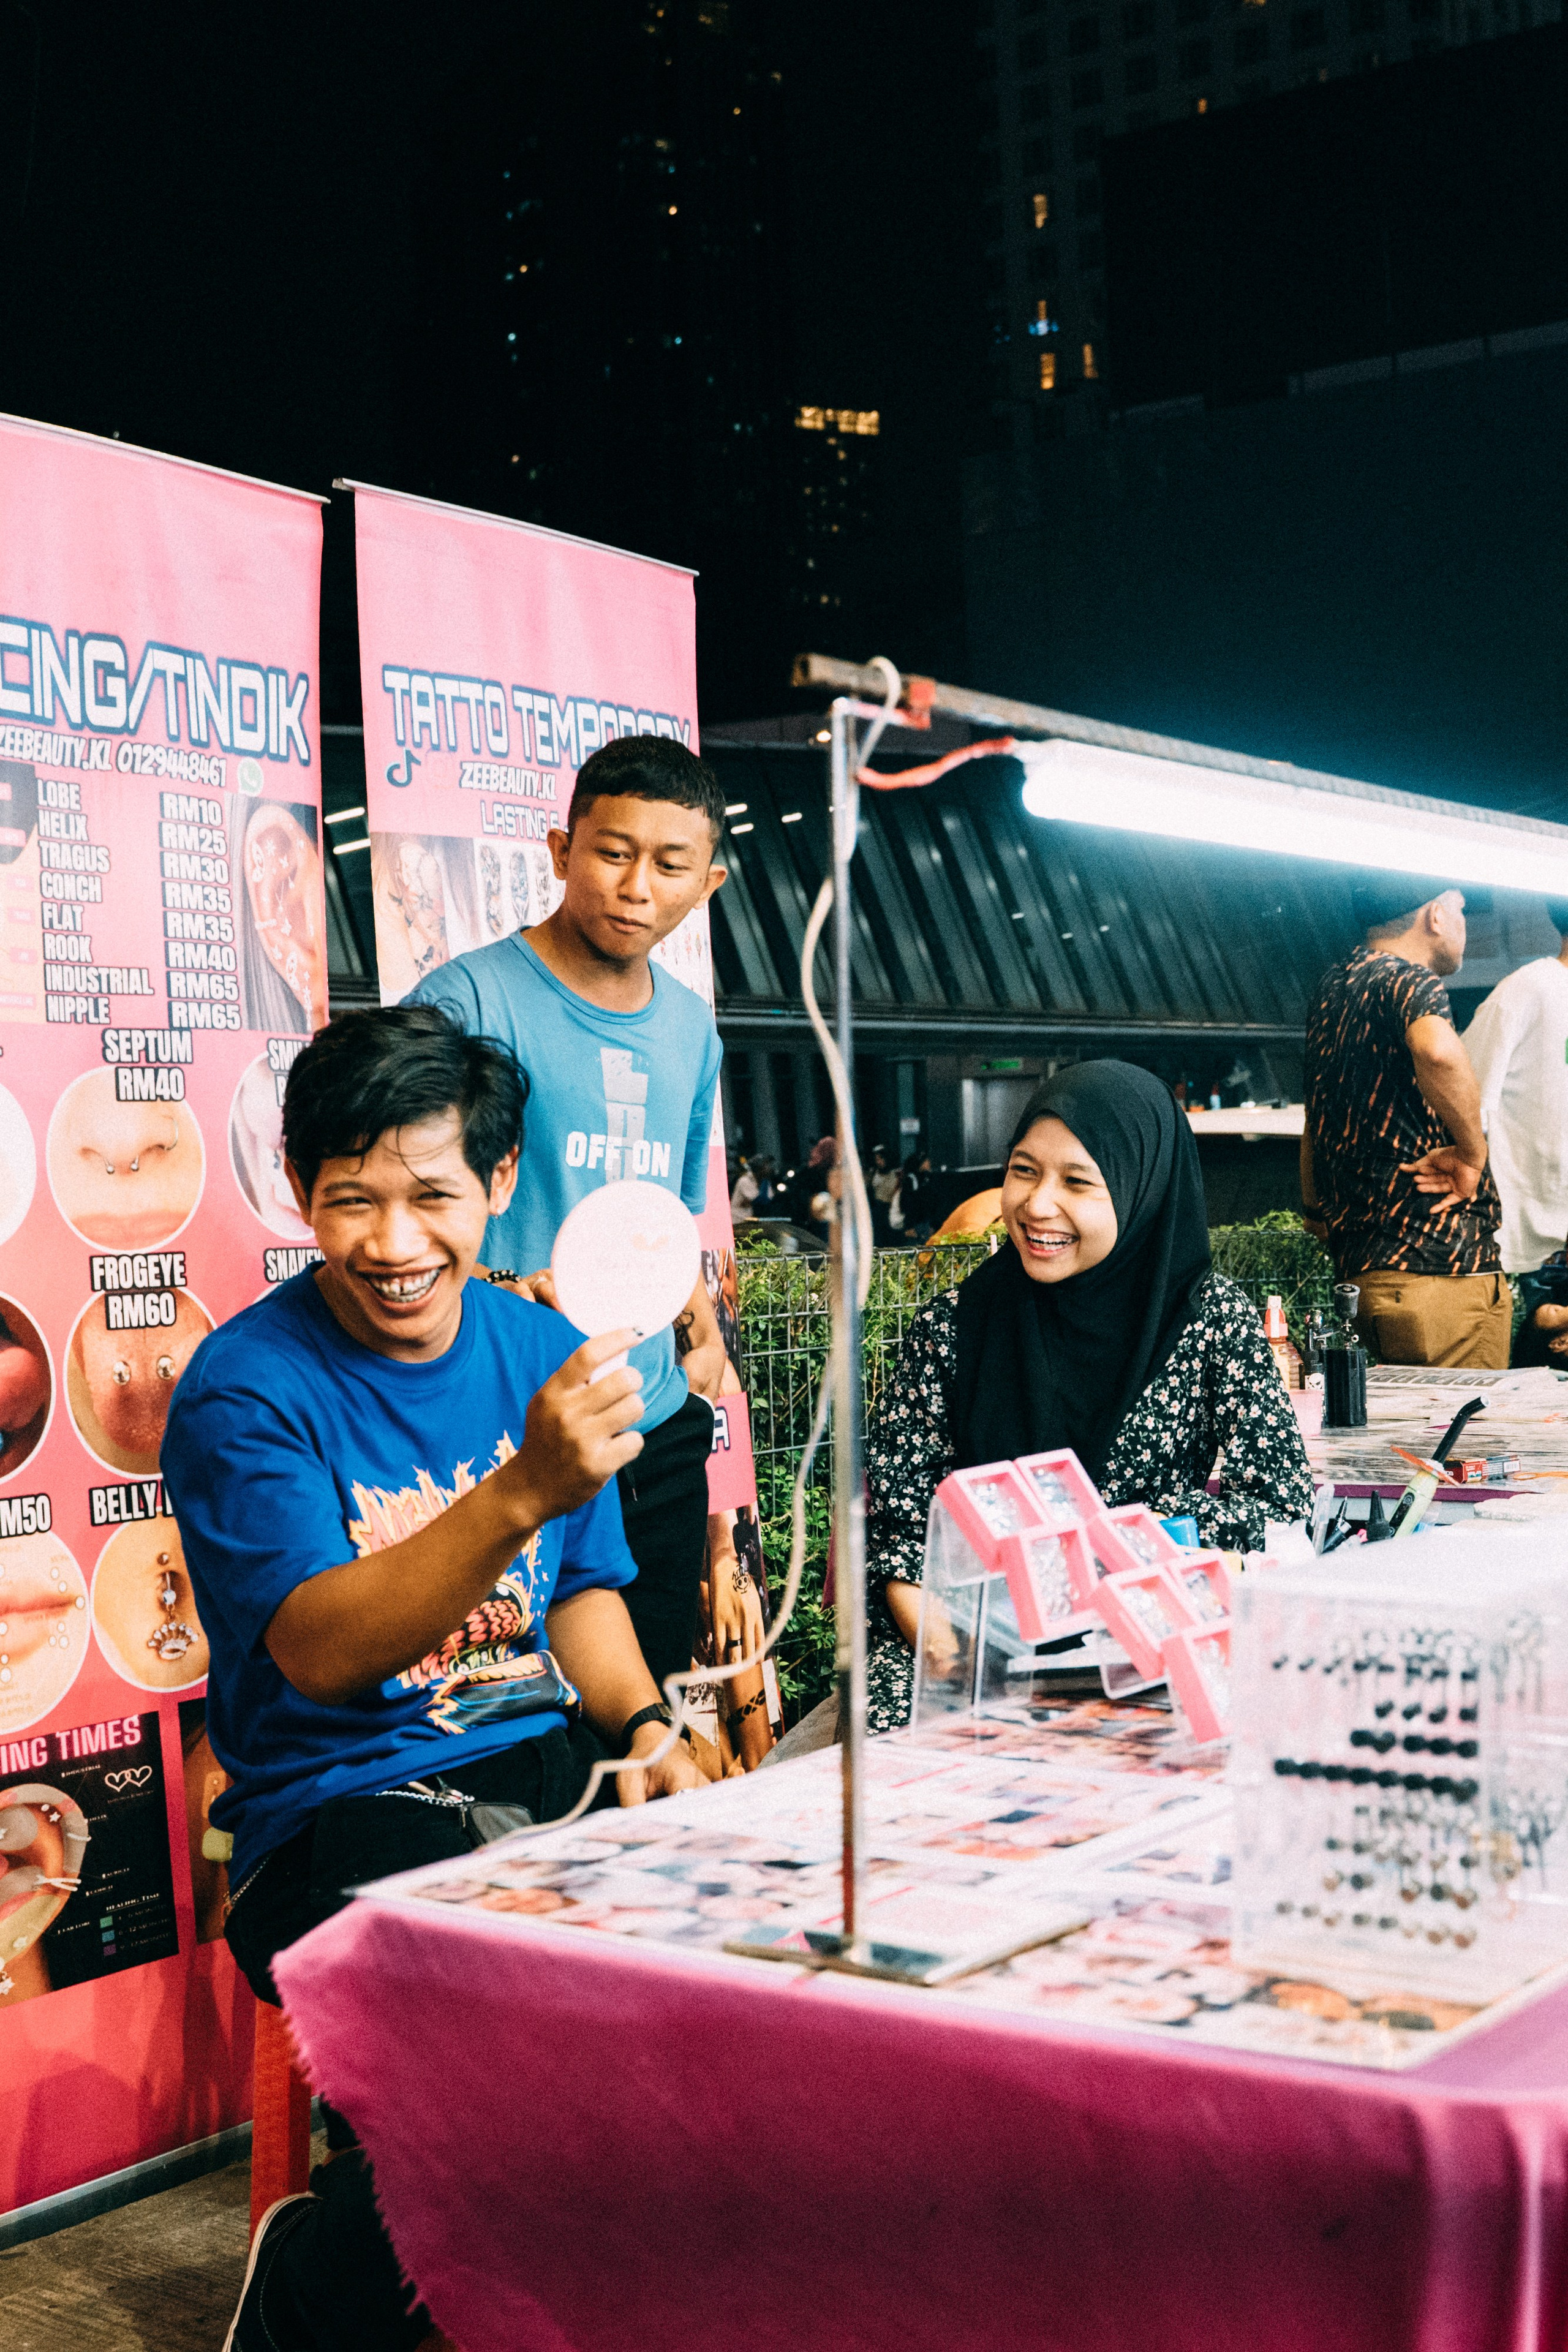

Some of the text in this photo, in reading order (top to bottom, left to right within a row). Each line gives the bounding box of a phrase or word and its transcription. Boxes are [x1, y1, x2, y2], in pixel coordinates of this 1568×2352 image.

[383, 669, 508, 755] TATTO
[117, 741, 227, 788] 0129448461
[461, 762, 557, 801] ZEEBEAUTY.KL
[37, 779, 222, 826] LOBE RM10
[481, 801, 547, 842] LASTING
[38, 810, 227, 856] HELIX RM25
[39, 841, 229, 884] TRAGUS RM30
[40, 872, 231, 914] CONCH RM35
[42, 902, 84, 932] FLAT
[165, 912, 233, 943] RM35
[43, 933, 236, 972] ROOK RM40
[45, 964, 238, 1001] INDUSTRIAL RM65
[46, 995, 110, 1024] NIPPLE
[169, 1002, 241, 1030] RM65
[104, 1029, 192, 1063] SEPTUM
[116, 1068, 185, 1101] RM40
[565, 1131, 671, 1178] OFF ON
[91, 1254, 186, 1290] FROGEYE
[106, 1292, 176, 1330] RM60
[0, 1494, 51, 1537] M50
[91, 1482, 157, 1526] BELLY
[0, 1714, 141, 1774] ING TIMES
